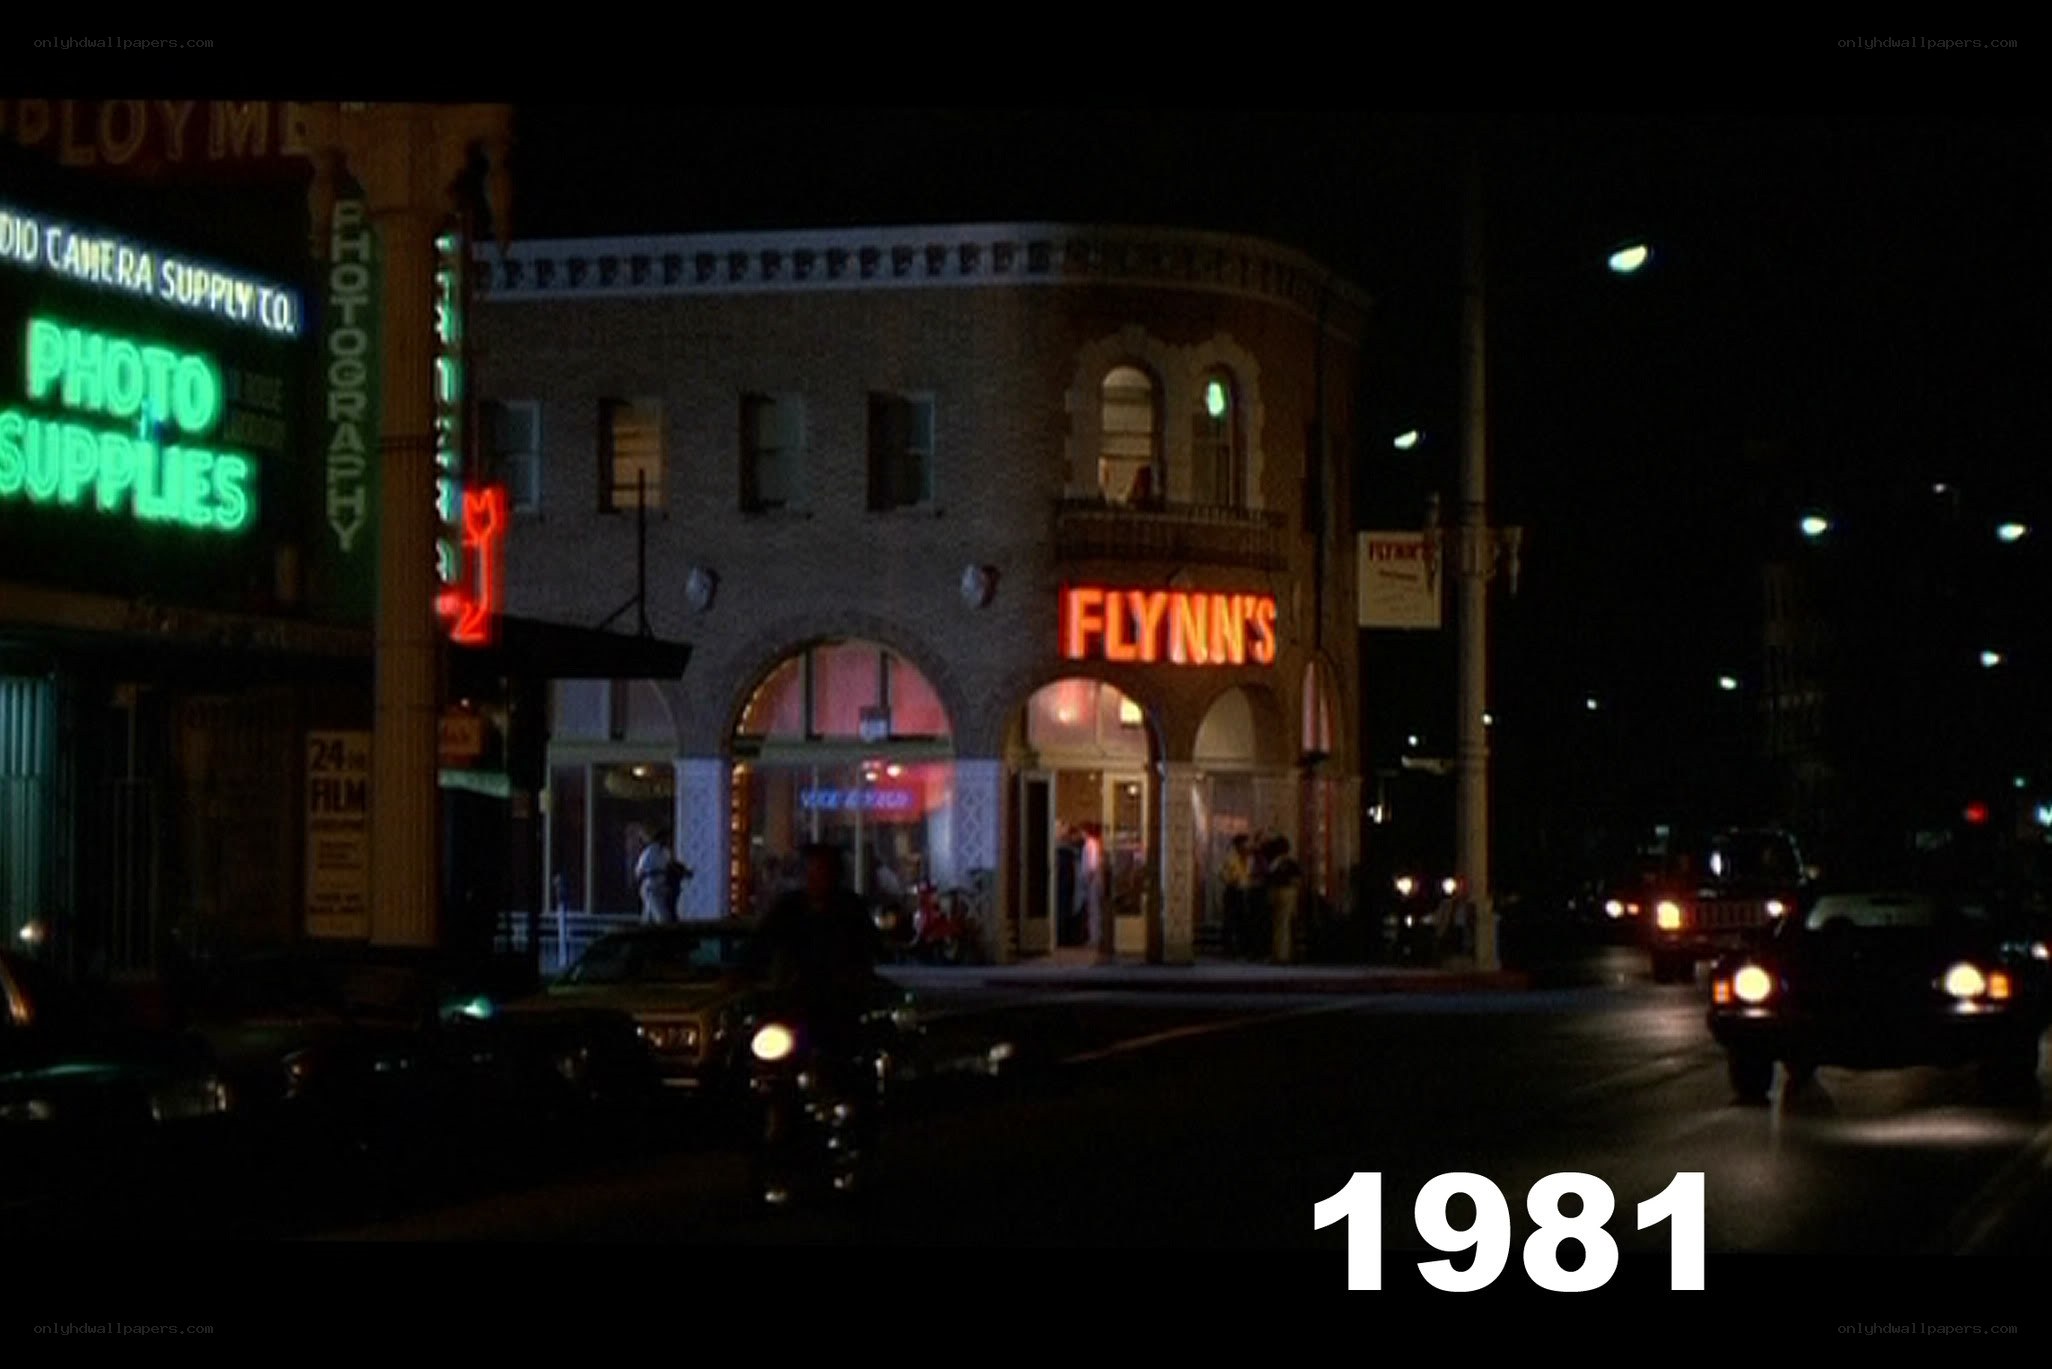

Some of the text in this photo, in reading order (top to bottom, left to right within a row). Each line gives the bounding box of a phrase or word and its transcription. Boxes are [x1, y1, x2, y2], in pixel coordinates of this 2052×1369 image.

[0, 99, 311, 166] PLOYME
[46, 225, 153, 294] CAMERA
[159, 258, 252, 319] SUPPLY
[258, 286, 296, 333] CO.
[27, 317, 216, 432] PHOTO
[326, 200, 371, 552] PHOTOGRAPHY
[0, 409, 251, 529] SUPPLIES
[1061, 586, 1277, 666] FLYNN'S
[311, 779, 366, 813] FILM
